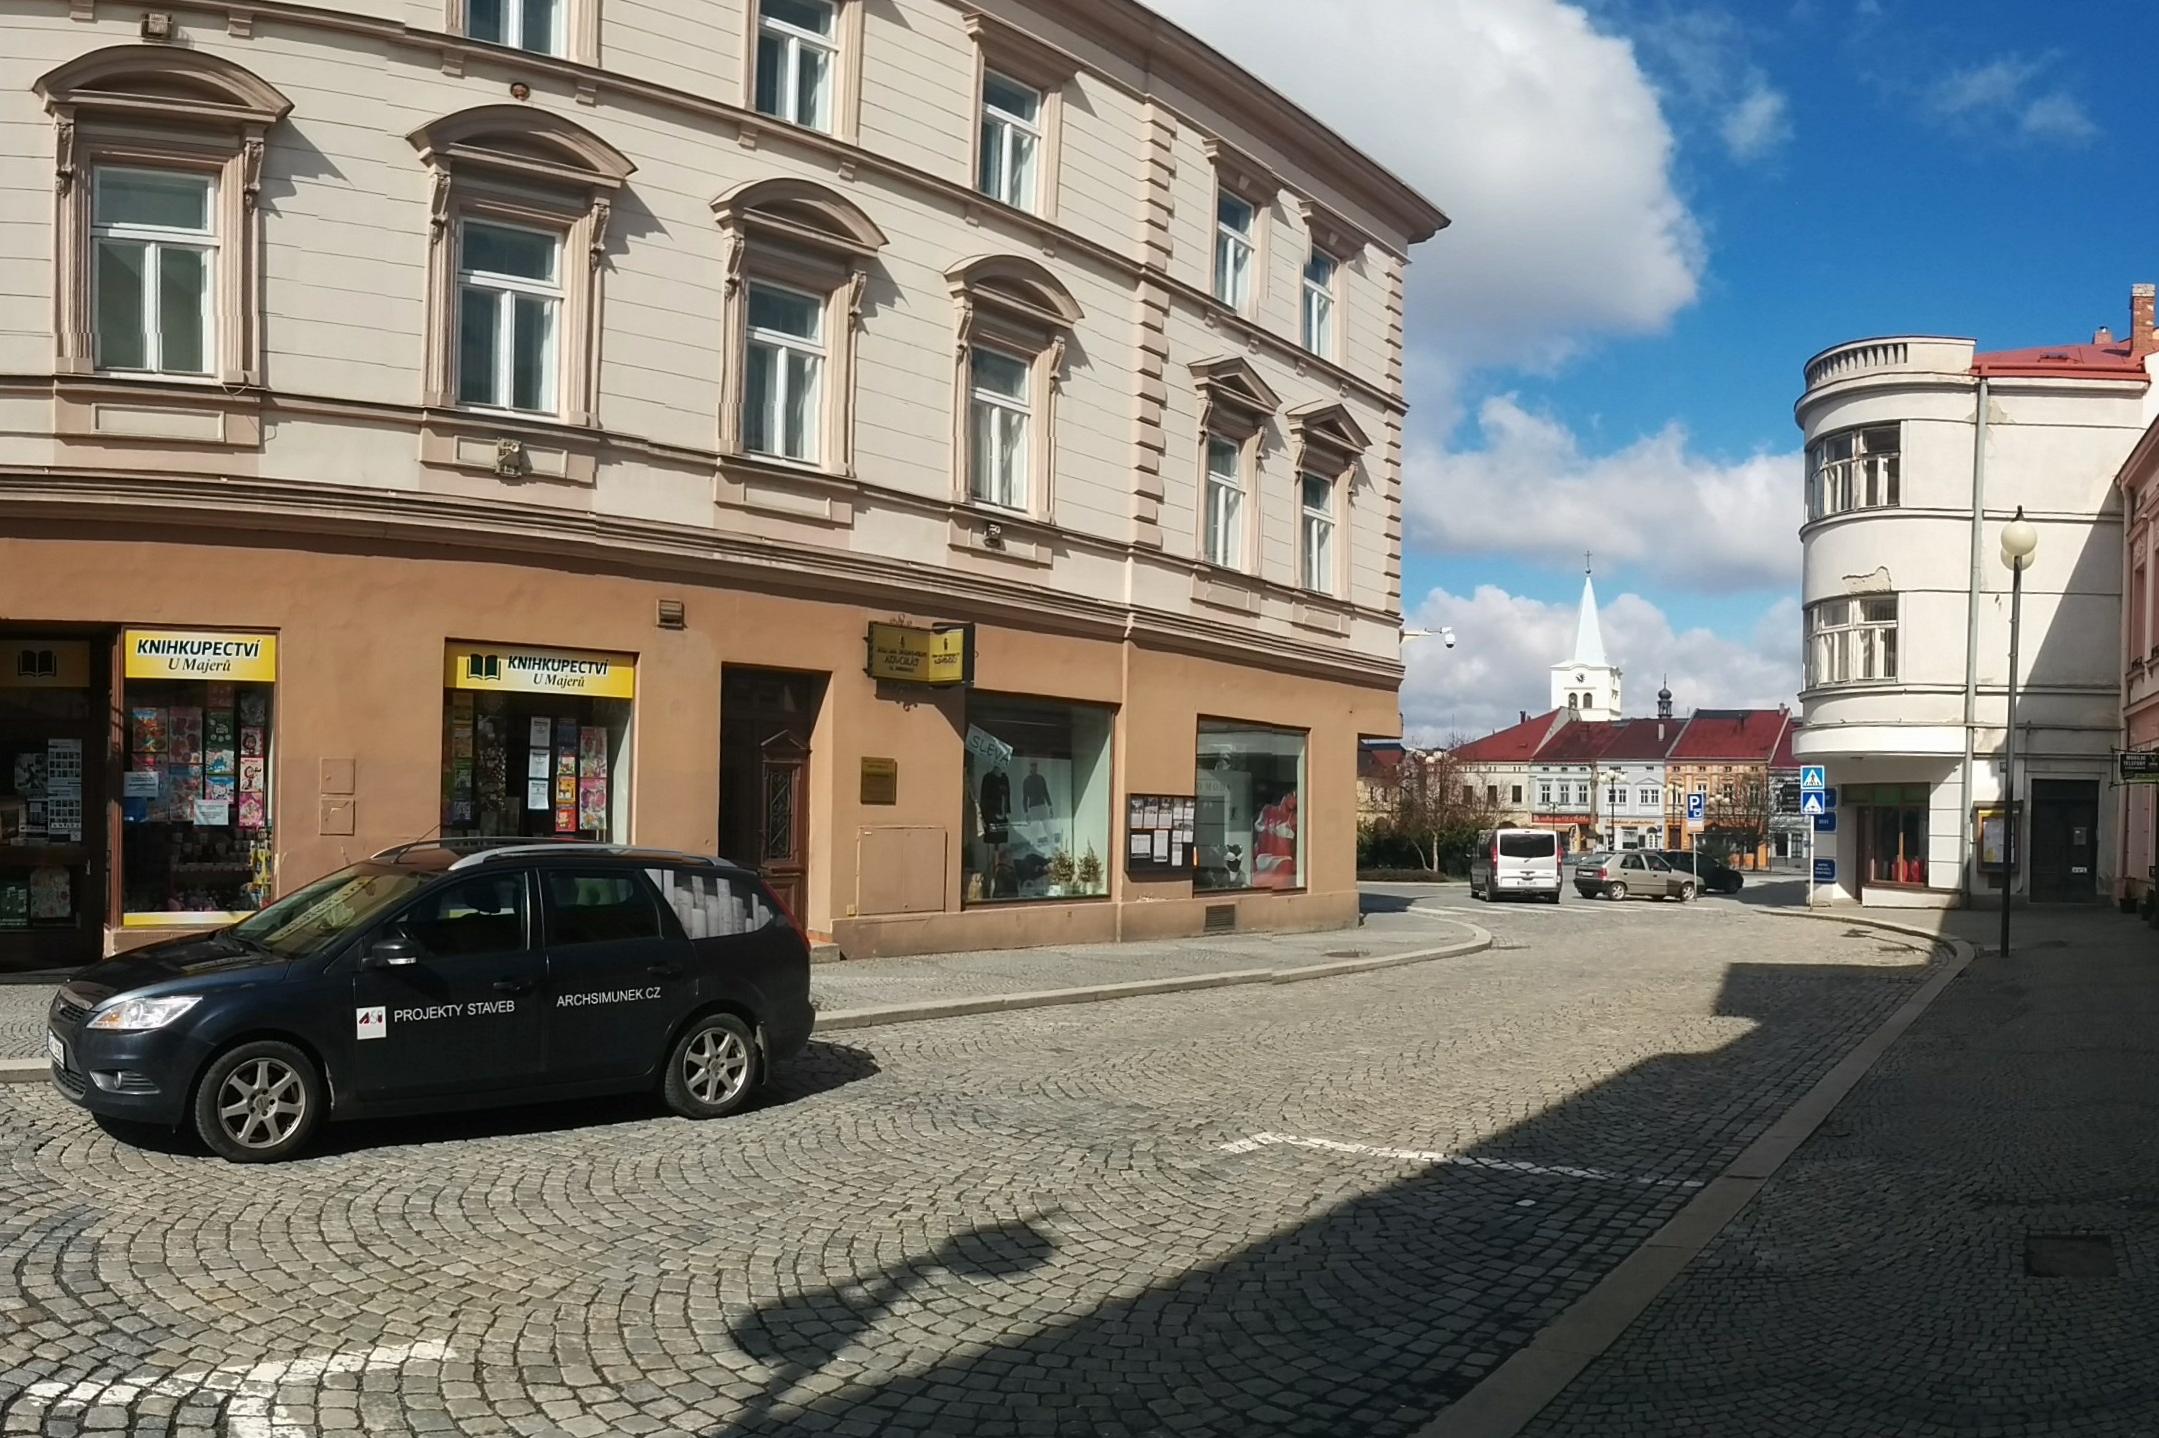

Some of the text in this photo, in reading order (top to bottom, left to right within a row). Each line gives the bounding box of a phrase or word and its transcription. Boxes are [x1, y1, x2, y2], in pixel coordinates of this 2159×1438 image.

[137, 639, 260, 657] KNIHKUPECTVÍ
[168, 658, 230, 673] U Majerů
[508, 655, 608, 674] KNIHKUPECTVÍ
[533, 673, 585, 688] U Majerů
[1689, 795, 1700, 811] P
[556, 987, 661, 1007] ARCHSIMUNEK.CZ
[394, 1001, 515, 1022] PROJEKTY STAVEB
